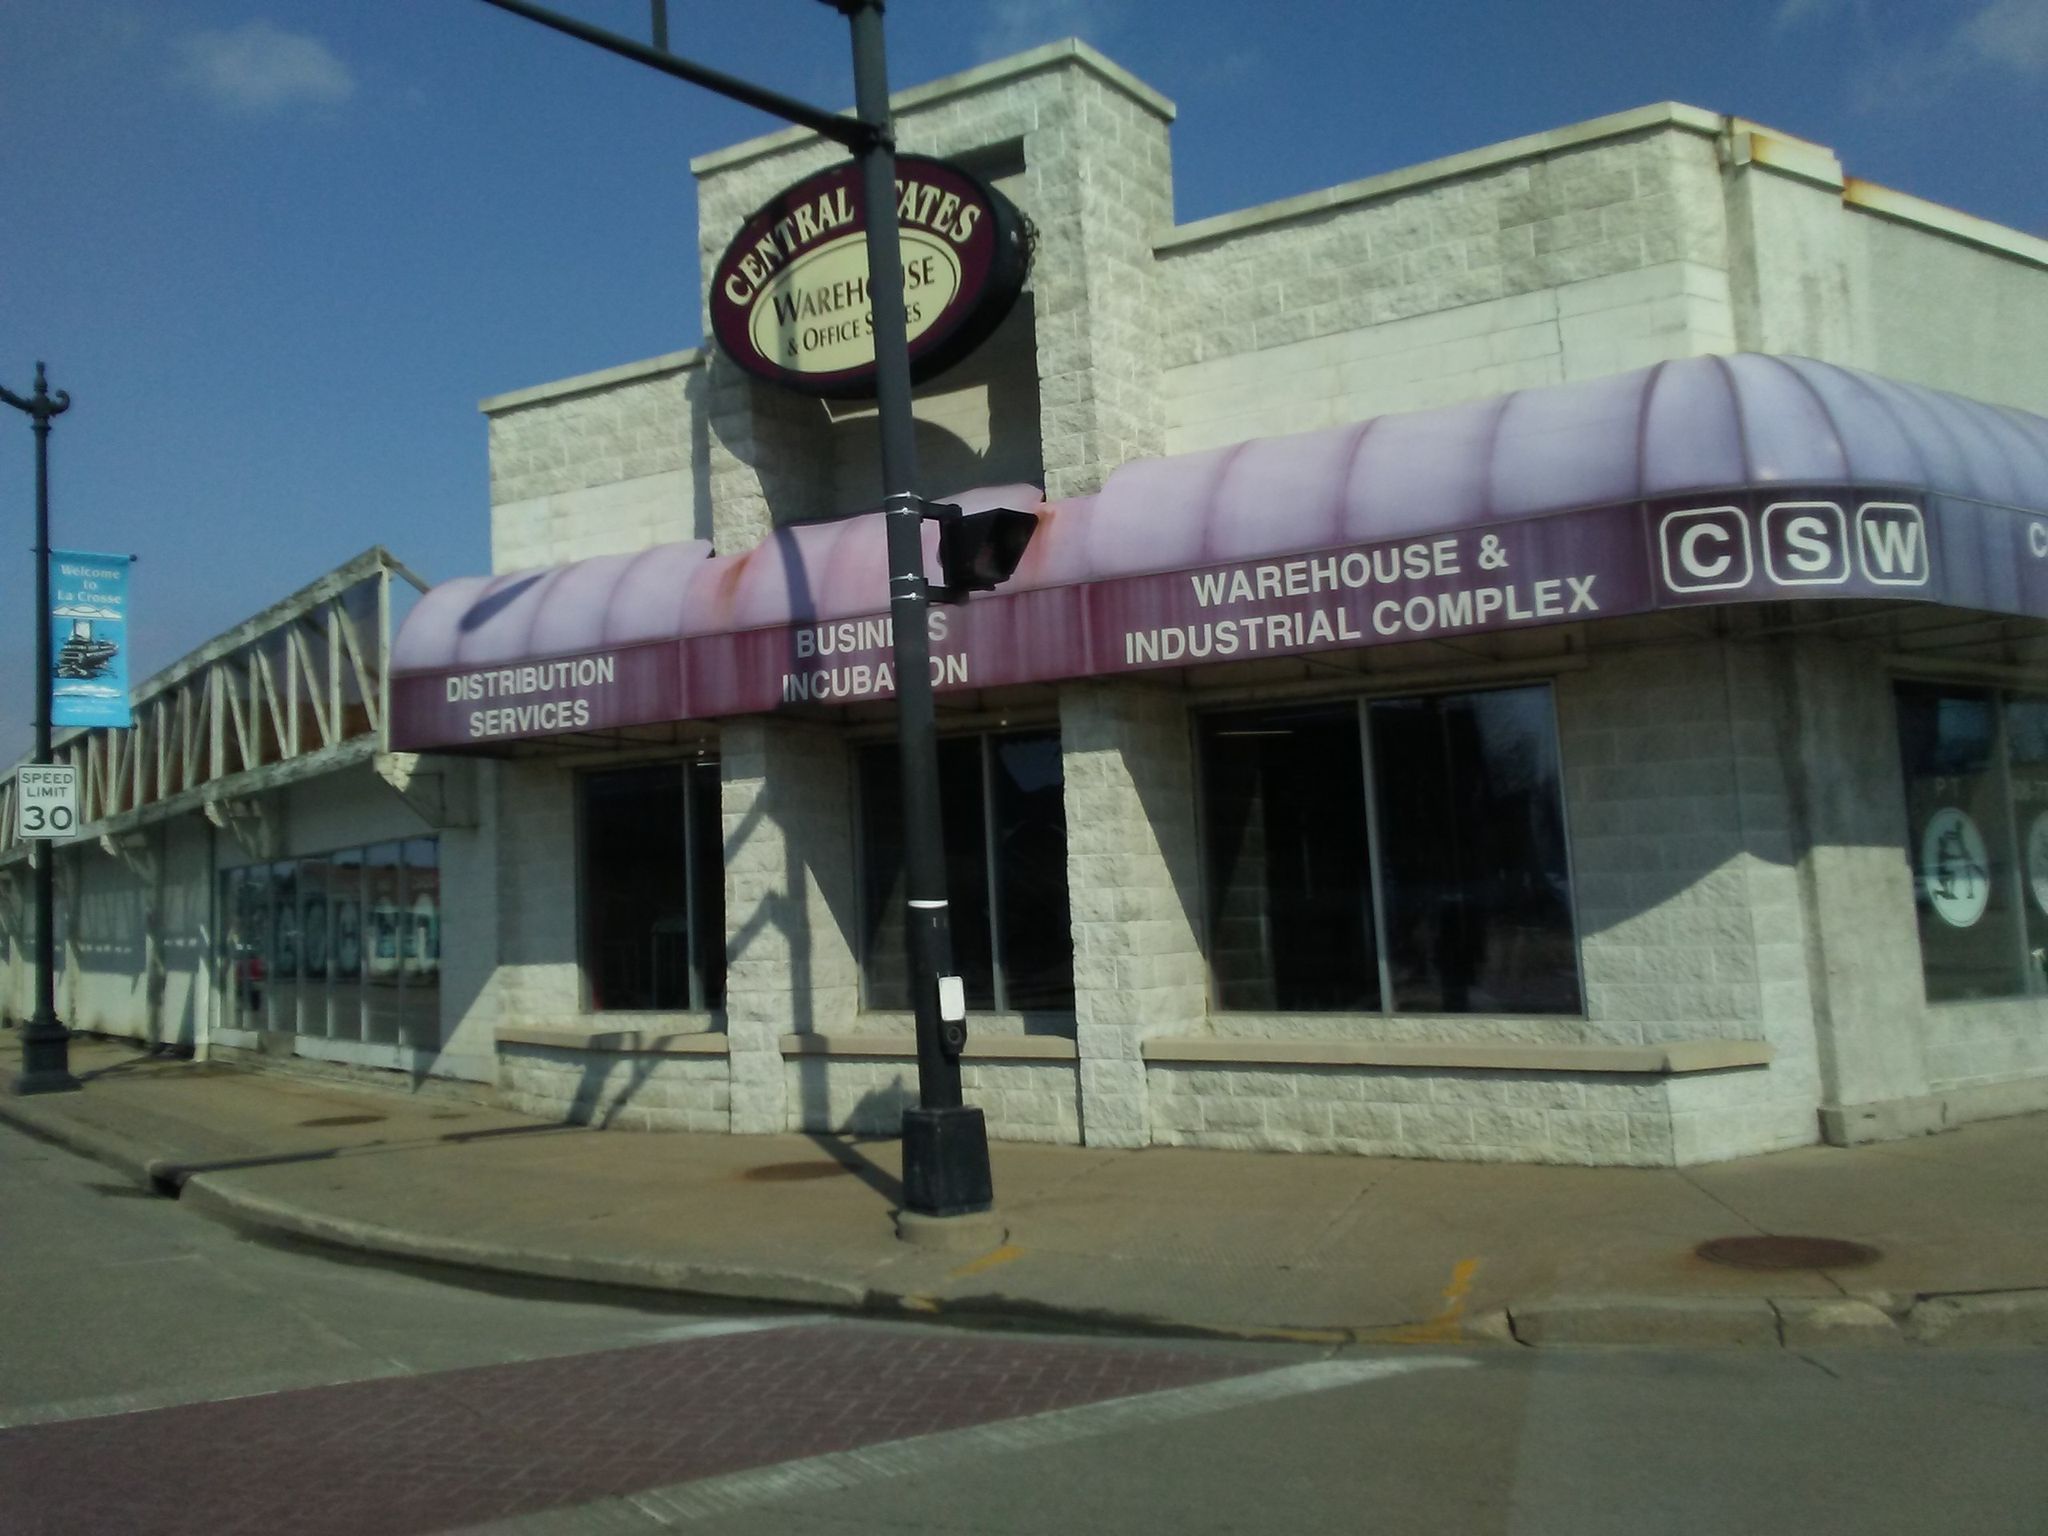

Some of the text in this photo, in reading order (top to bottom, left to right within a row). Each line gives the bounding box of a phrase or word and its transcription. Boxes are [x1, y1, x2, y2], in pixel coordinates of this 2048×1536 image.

[725, 179, 983, 306] CENTRAL ATES
[772, 256, 936, 327] WAREHSE
[787, 337, 799, 357] &
[803, 319, 861, 352] OFFICE
[60, 564, 121, 580] Welcome
[83, 579, 98, 591] to
[1190, 534, 1510, 607] WAREHOUSE &
[57, 589, 121, 605] La Crosse
[796, 611, 948, 658] BUSINS
[1125, 574, 1599, 665] INDUSTRIAL COMPLEX
[445, 656, 616, 703] DISTRIBUTION
[782, 653, 968, 702] INCUBAON
[469, 699, 591, 738] SERVICES
[21, 772, 74, 785] SPEED
[26, 786, 68, 798] LIMIT
[23, 805, 73, 831] 30
